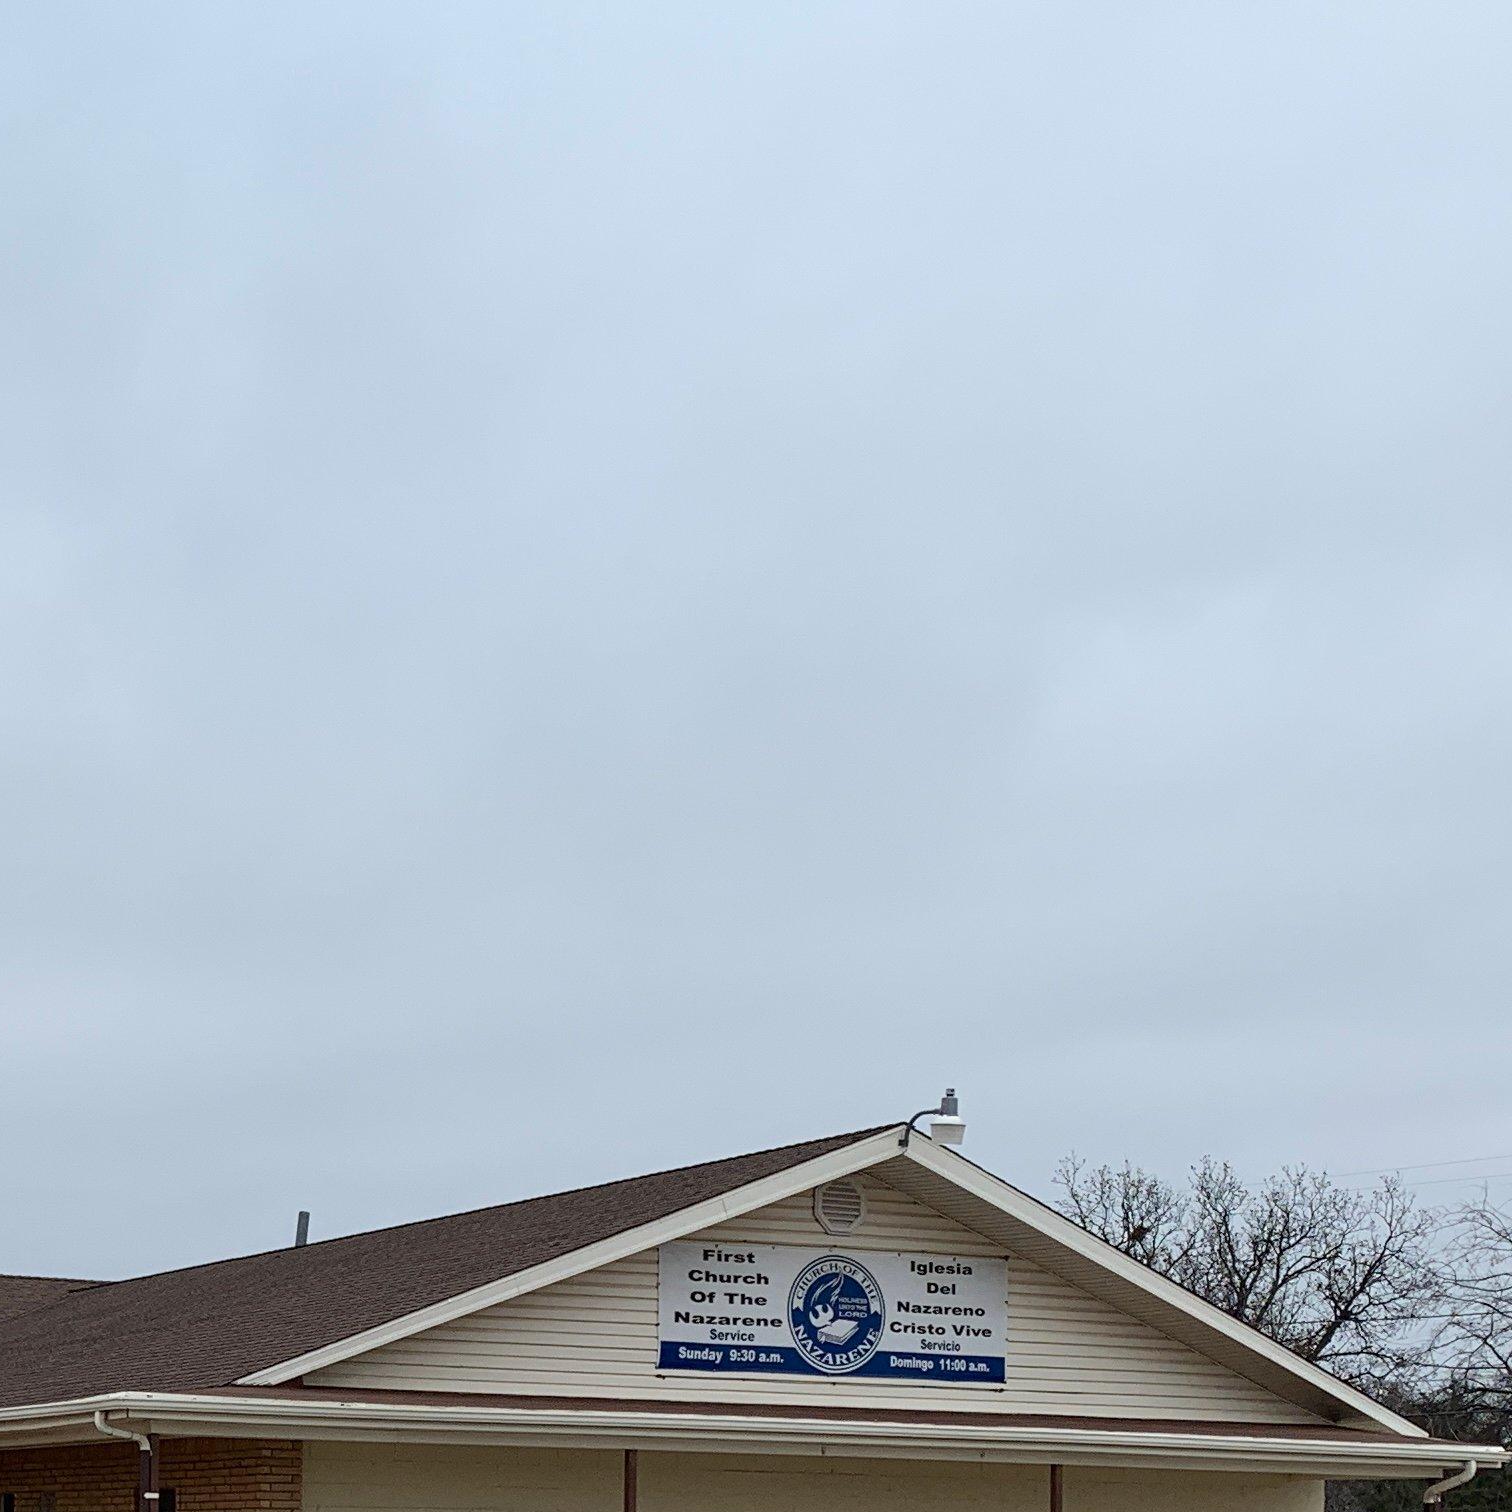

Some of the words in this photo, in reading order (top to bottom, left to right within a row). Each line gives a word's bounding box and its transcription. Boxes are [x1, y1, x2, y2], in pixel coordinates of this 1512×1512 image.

[702, 1249, 756, 1264] First
[910, 1260, 973, 1276] Iglesia
[688, 1269, 769, 1285] Church
[796, 1262, 838, 1301] CHURCH
[926, 1282, 956, 1295] Del
[690, 1291, 716, 1303] Of
[724, 1292, 768, 1306] The
[838, 1311, 868, 1319] LORD
[896, 1301, 986, 1317] Nazareno
[674, 1311, 783, 1328] Nazarene
[709, 1328, 755, 1342] Service
[889, 1321, 946, 1336] Cristo
[952, 1324, 993, 1338] Vive
[794, 1323, 880, 1366] NAZARENE
[920, 1338, 961, 1352] Servicio
[678, 1346, 723, 1363] Sunday
[729, 1349, 756, 1362] 9:30
[758, 1352, 785, 1363] a.m.
[890, 1355, 934, 1372] Domingo
[939, 1358, 967, 1371] 11:00
[968, 1361, 991, 1372] a.m.
